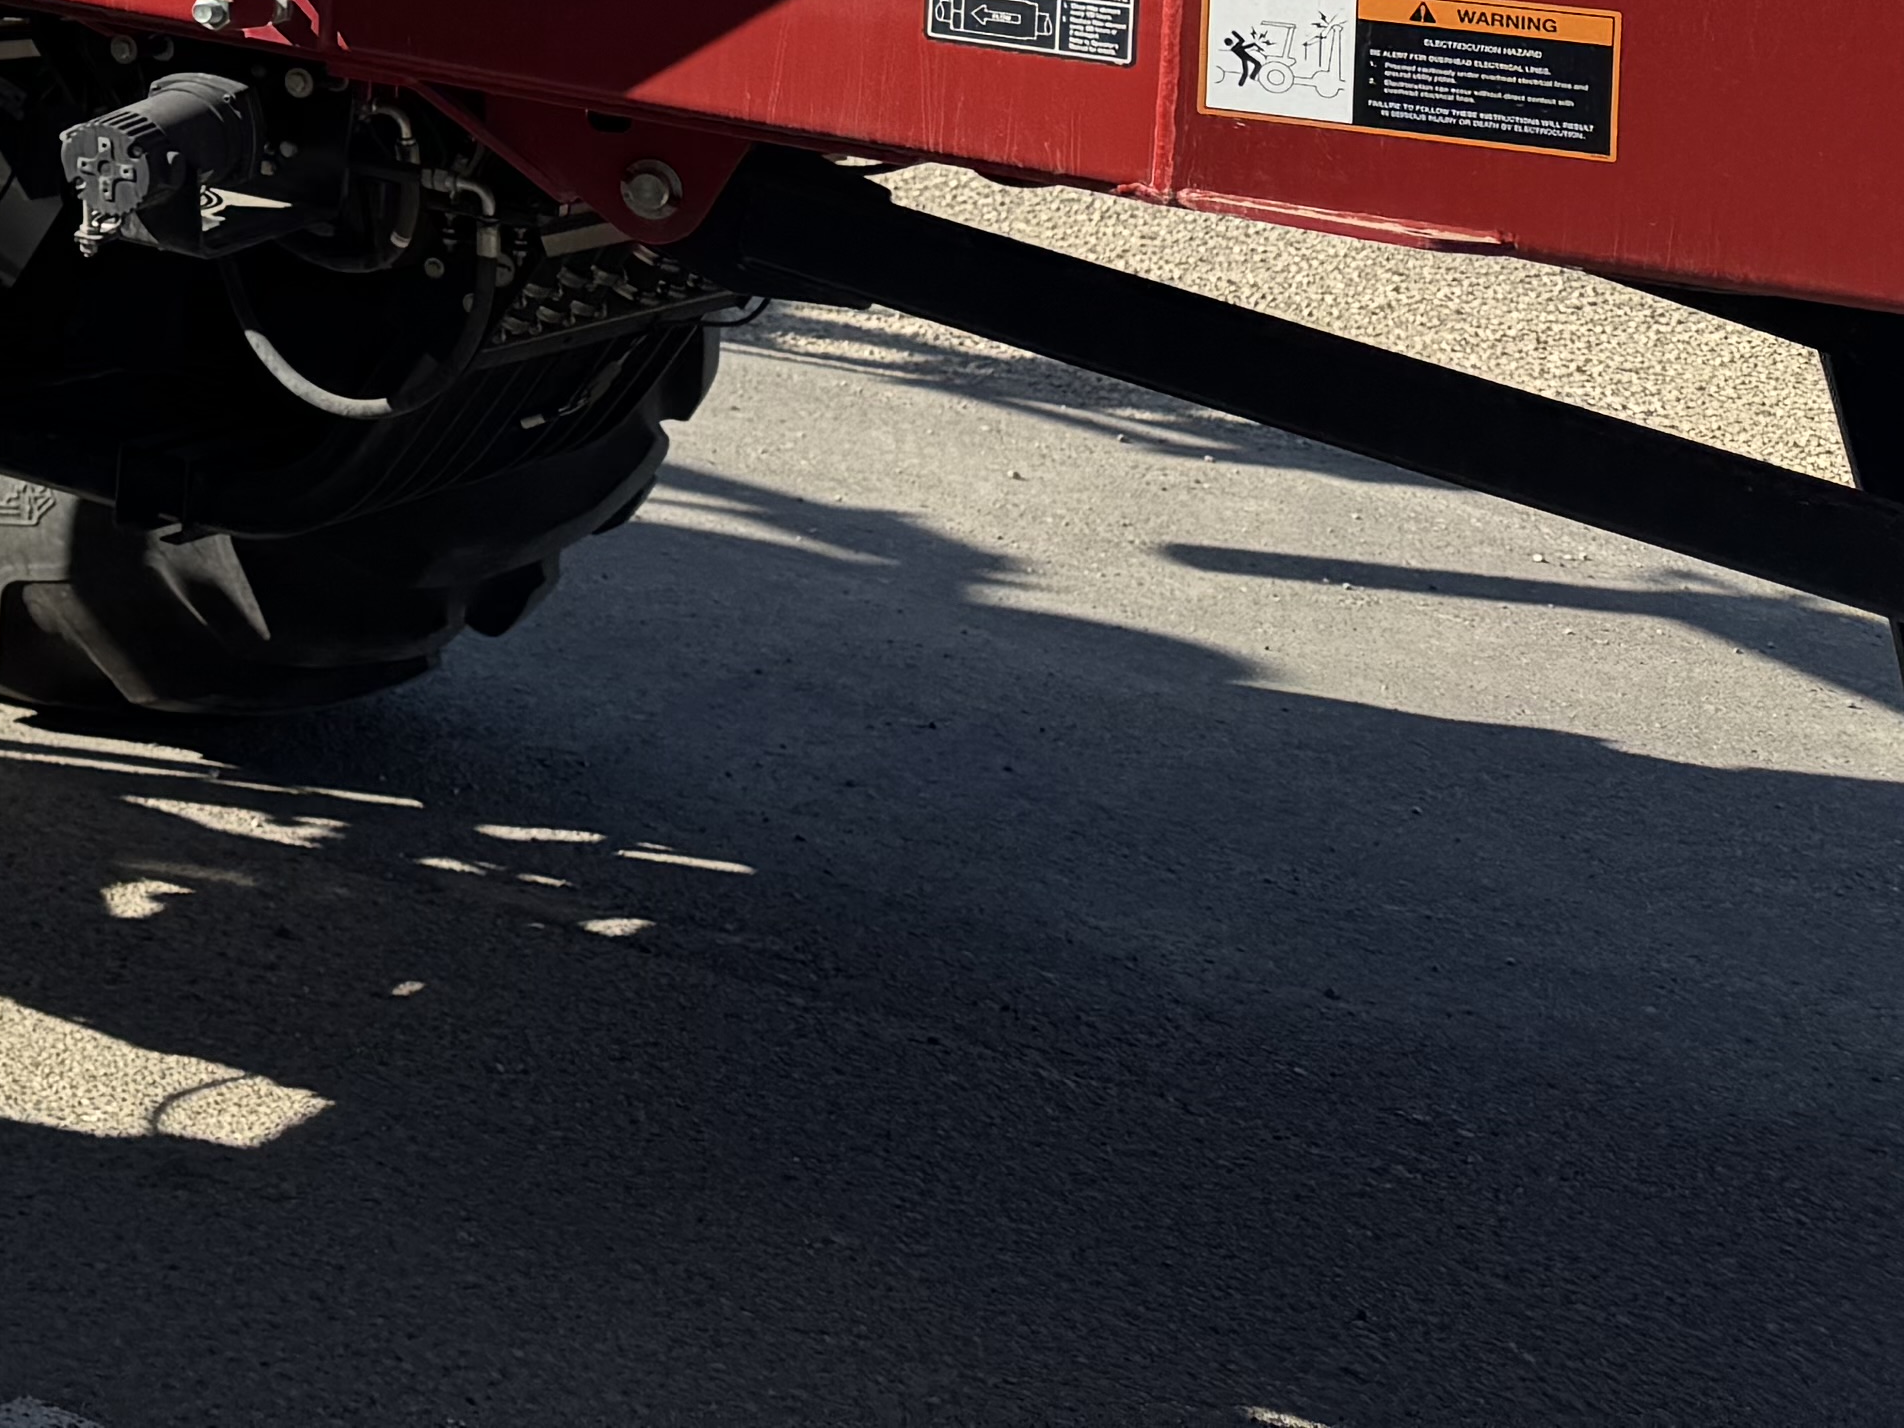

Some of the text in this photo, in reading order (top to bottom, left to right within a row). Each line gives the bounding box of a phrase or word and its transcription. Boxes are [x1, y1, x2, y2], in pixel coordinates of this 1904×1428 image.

[1456, 8, 1558, 33] WARNING
[1423, 38, 1543, 59] ELECTROCUTION HAZARD
[1382, 50, 1409, 60] ALERT
[1409, 53, 1428, 62] FOR
[1428, 55, 1473, 67] OVERHEAD
[1473, 60, 1524, 73] ELECTRICAL
[1367, 99, 1402, 110] FAILURE
[1415, 105, 1450, 116] FOLLOW
[1451, 109, 1478, 119] THESE
[1479, 112, 1540, 126] INSTRUCTIONS
[1540, 119, 1561, 129] WILL
[1472, 120, 1500, 130] DEATH
